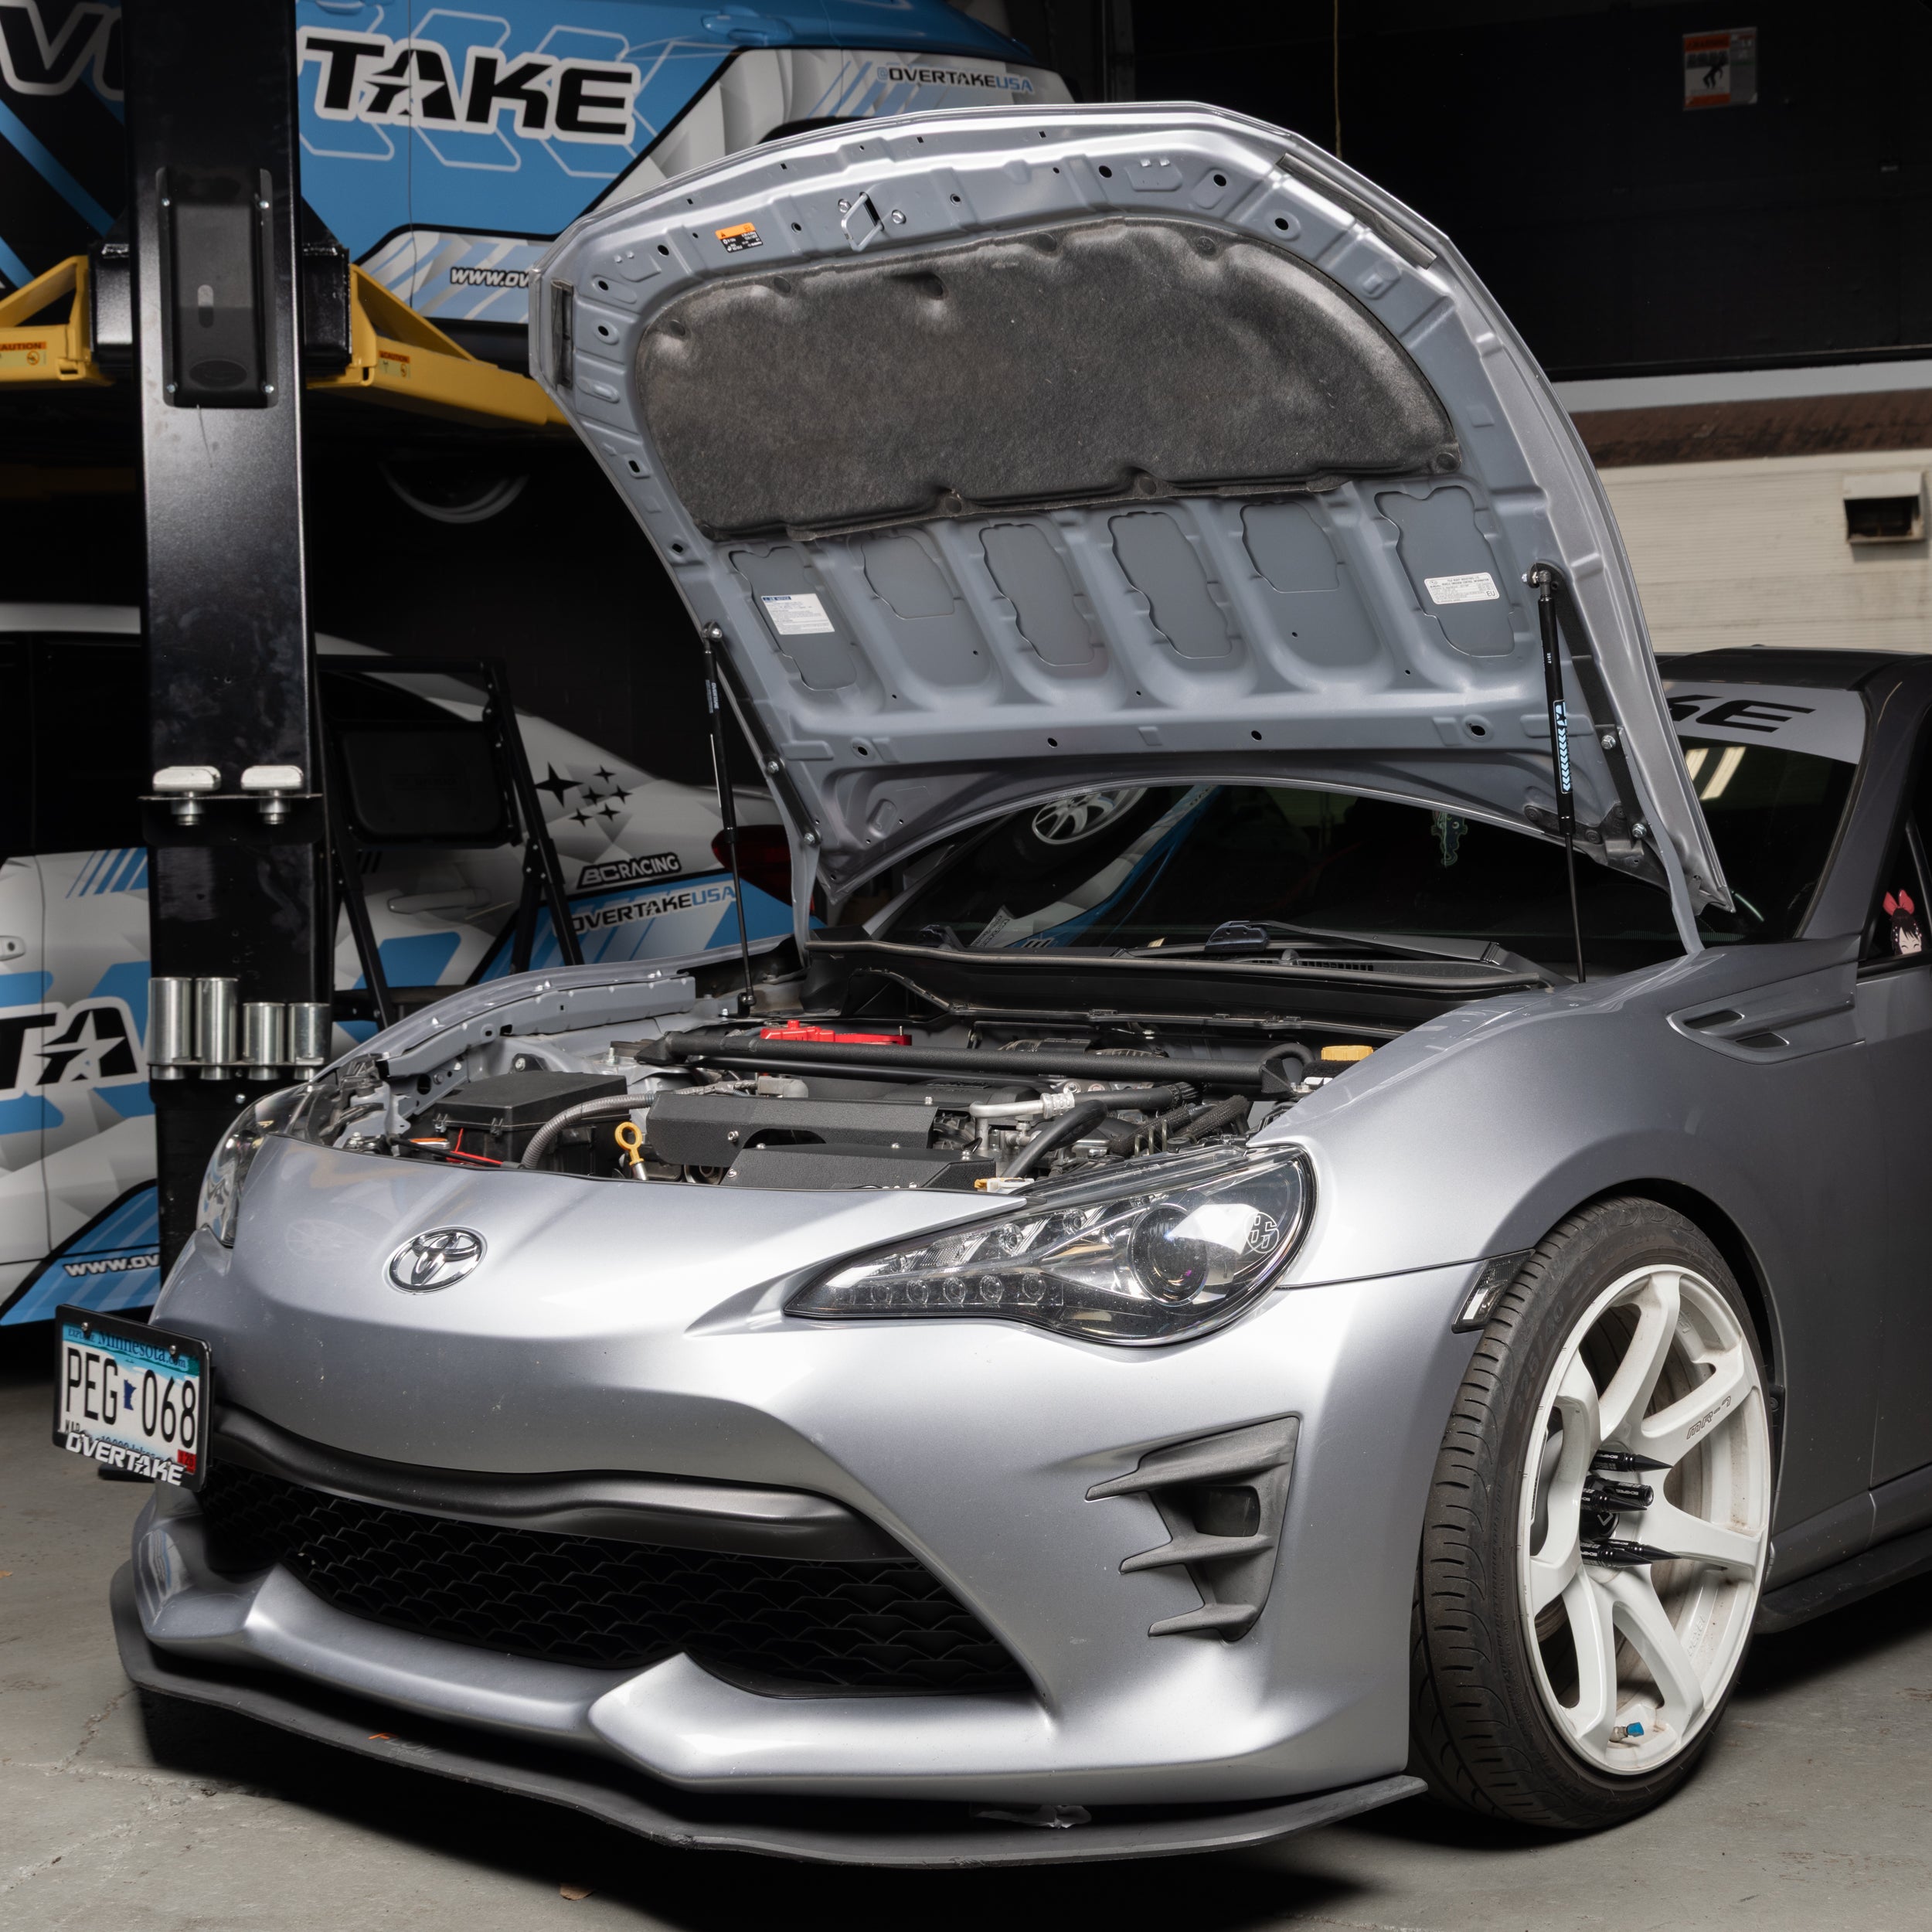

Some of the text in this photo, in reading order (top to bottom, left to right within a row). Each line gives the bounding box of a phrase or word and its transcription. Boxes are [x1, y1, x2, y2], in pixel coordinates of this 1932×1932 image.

[306, 36, 633, 135] TAKE
[877, 66, 1033, 93] @OVERTAKEUSA
[66, 1346, 196, 1449] PEG 068
[1686, 1396, 1731, 1440] MR-7
[65, 1431, 187, 1486] OVERTAKE
